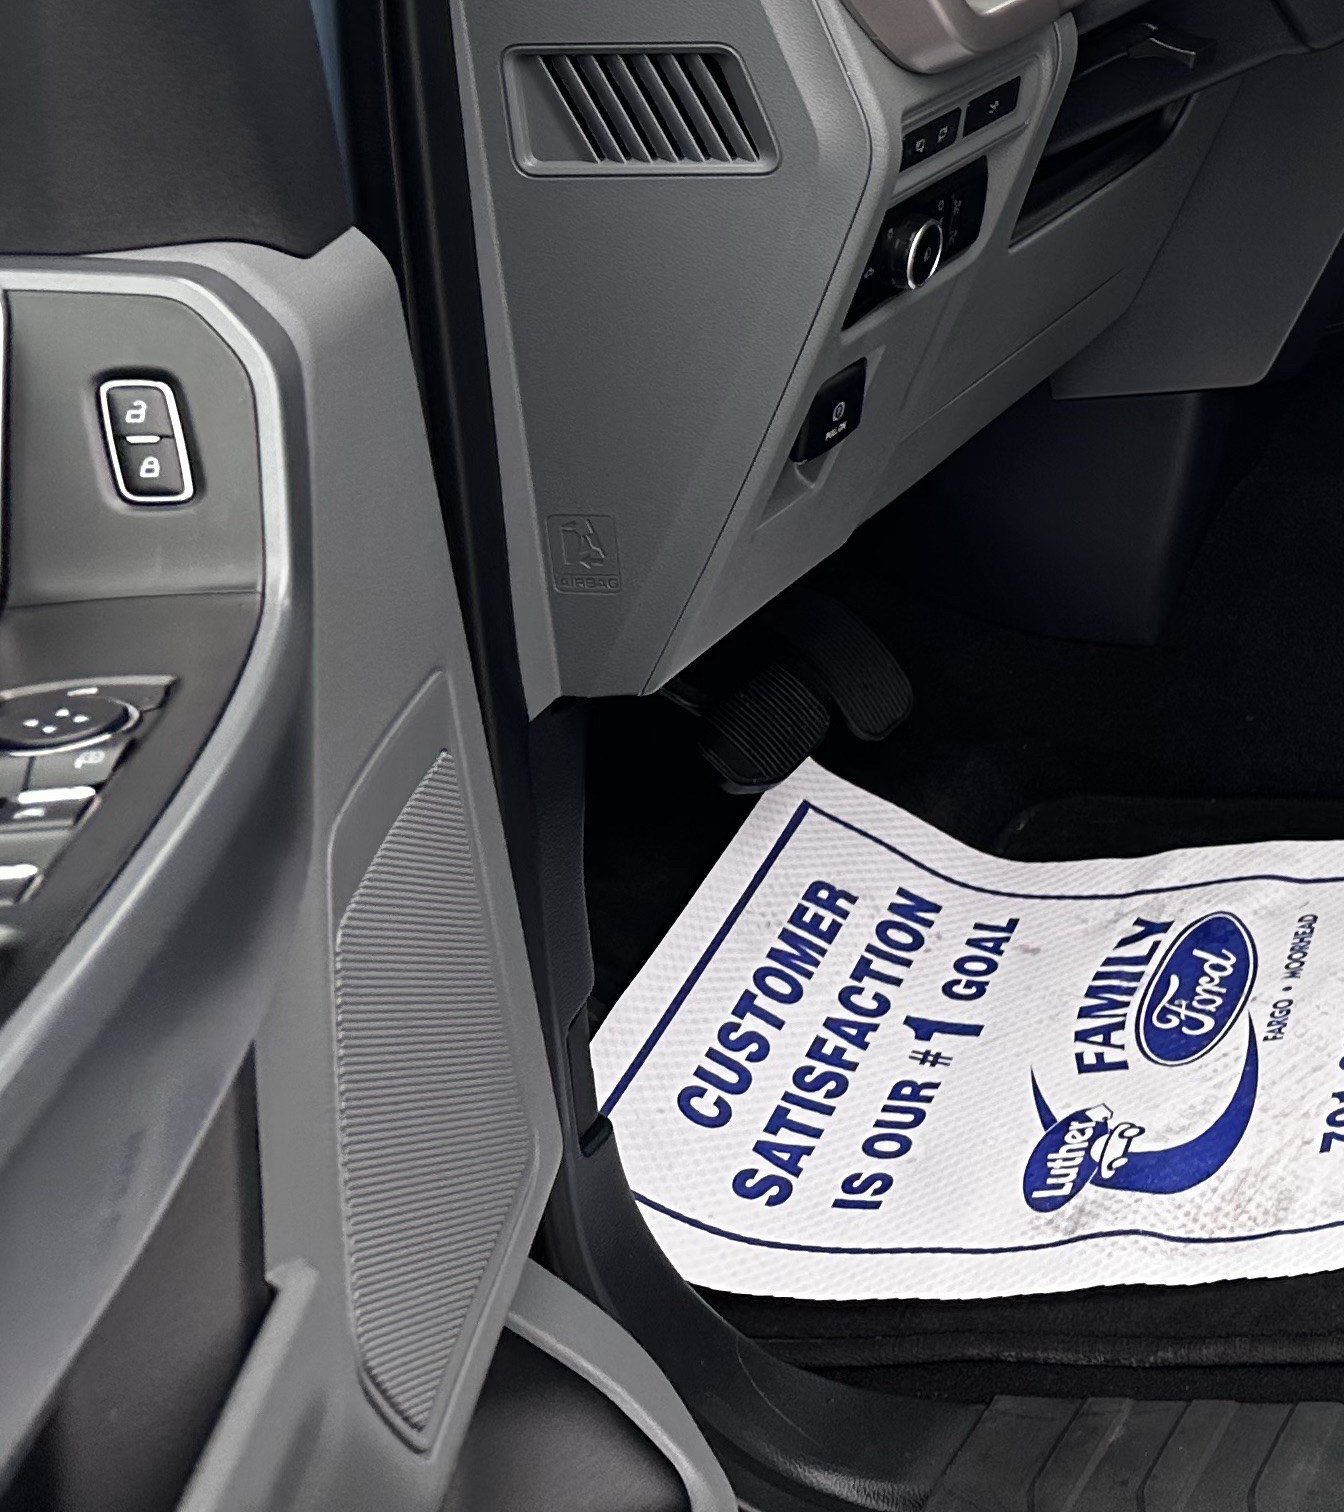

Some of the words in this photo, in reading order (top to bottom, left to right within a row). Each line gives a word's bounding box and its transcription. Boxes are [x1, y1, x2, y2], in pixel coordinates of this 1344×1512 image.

[560, 577, 618, 589] AIRBAG
[941, 918, 1020, 1001] GOAL
[1074, 917, 1175, 1075] FAMILY
[1151, 949, 1237, 1036] Ford
[1263, 998, 1294, 1042] FARGO
[1282, 914, 1318, 979] MOORHEAD
[677, 879, 859, 1129] CUSTOMER
[731, 886, 943, 1207] SATISFACTION
[861, 1079, 942, 1159] OUR
[1031, 1118, 1098, 1199] Luther
[831, 1172, 894, 1210] IS
